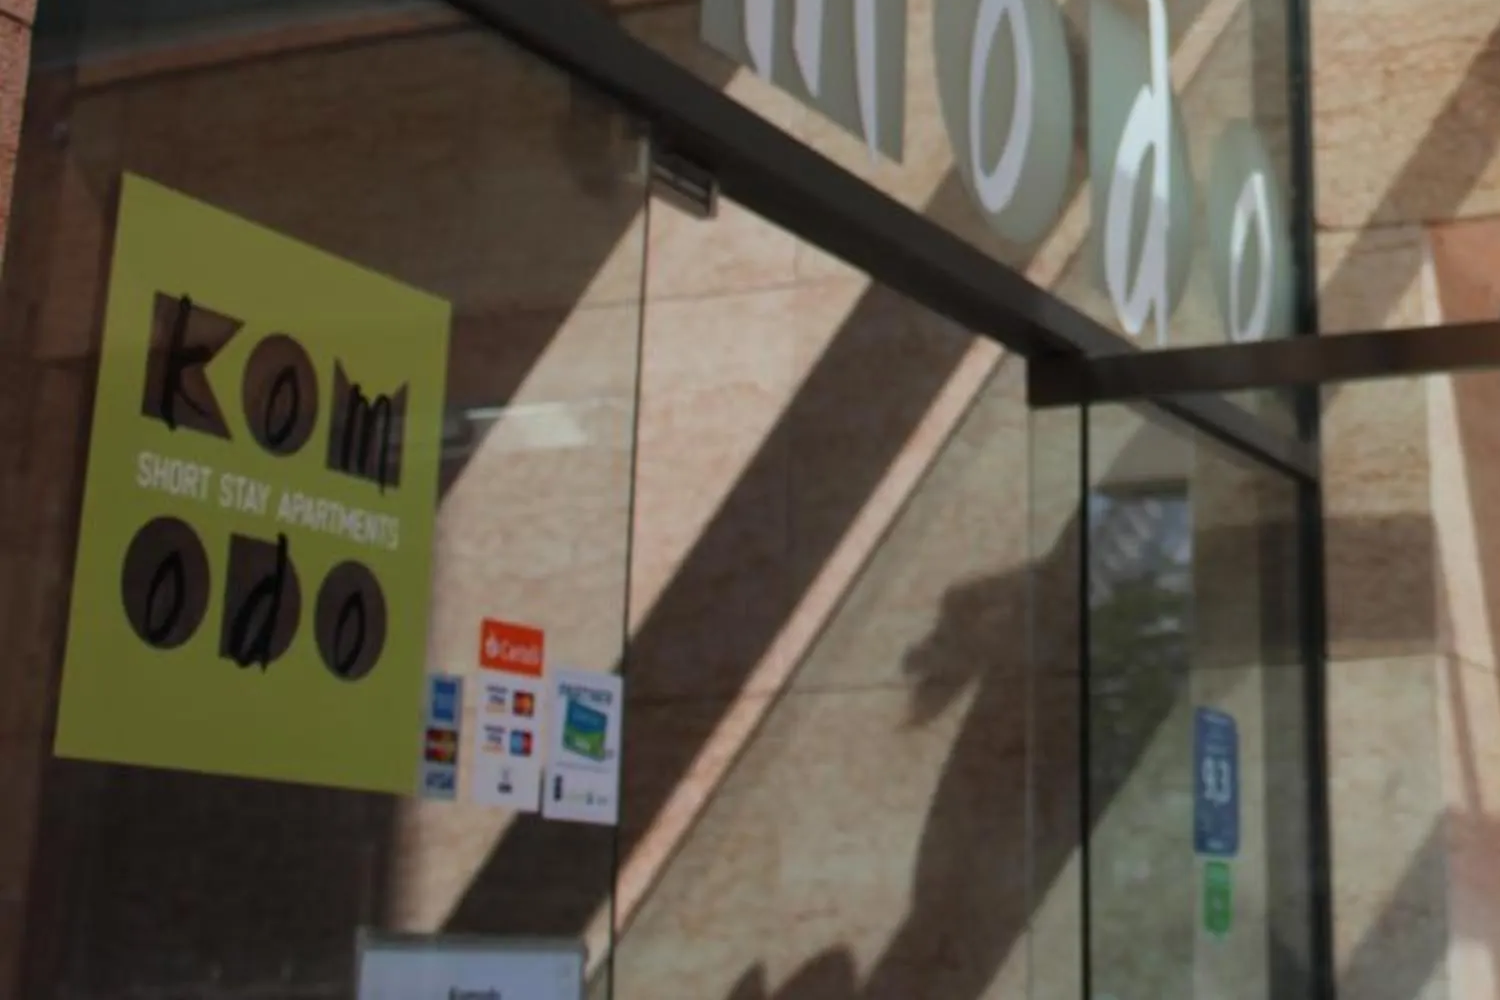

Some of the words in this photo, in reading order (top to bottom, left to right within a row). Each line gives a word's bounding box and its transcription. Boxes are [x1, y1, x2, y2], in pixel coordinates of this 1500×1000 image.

[136, 451, 212, 501] SHORT
[219, 471, 270, 517] STAY
[275, 489, 399, 550] APARTMENTS
